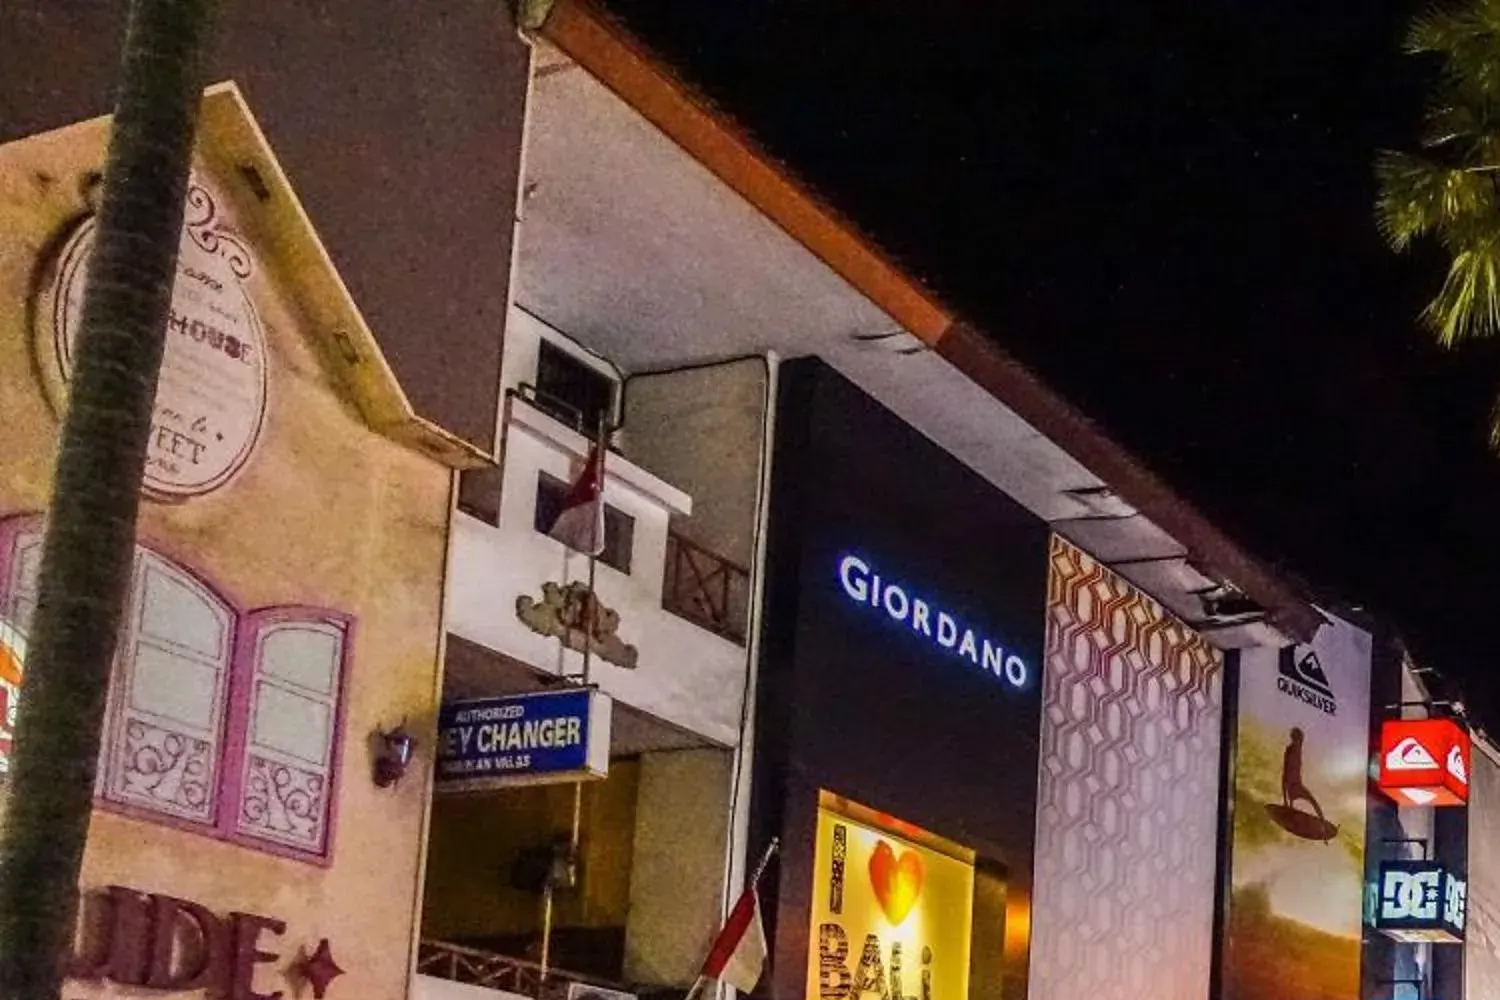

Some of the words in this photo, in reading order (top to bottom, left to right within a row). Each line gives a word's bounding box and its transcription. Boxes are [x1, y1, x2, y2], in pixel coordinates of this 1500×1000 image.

[168, 312, 254, 366] HOUSE
[150, 424, 206, 466] EET
[840, 555, 1027, 687] GIORDANO
[456, 705, 525, 723] AUTHORIZED
[477, 716, 582, 753] CHANGER
[1382, 871, 1439, 919] DC
